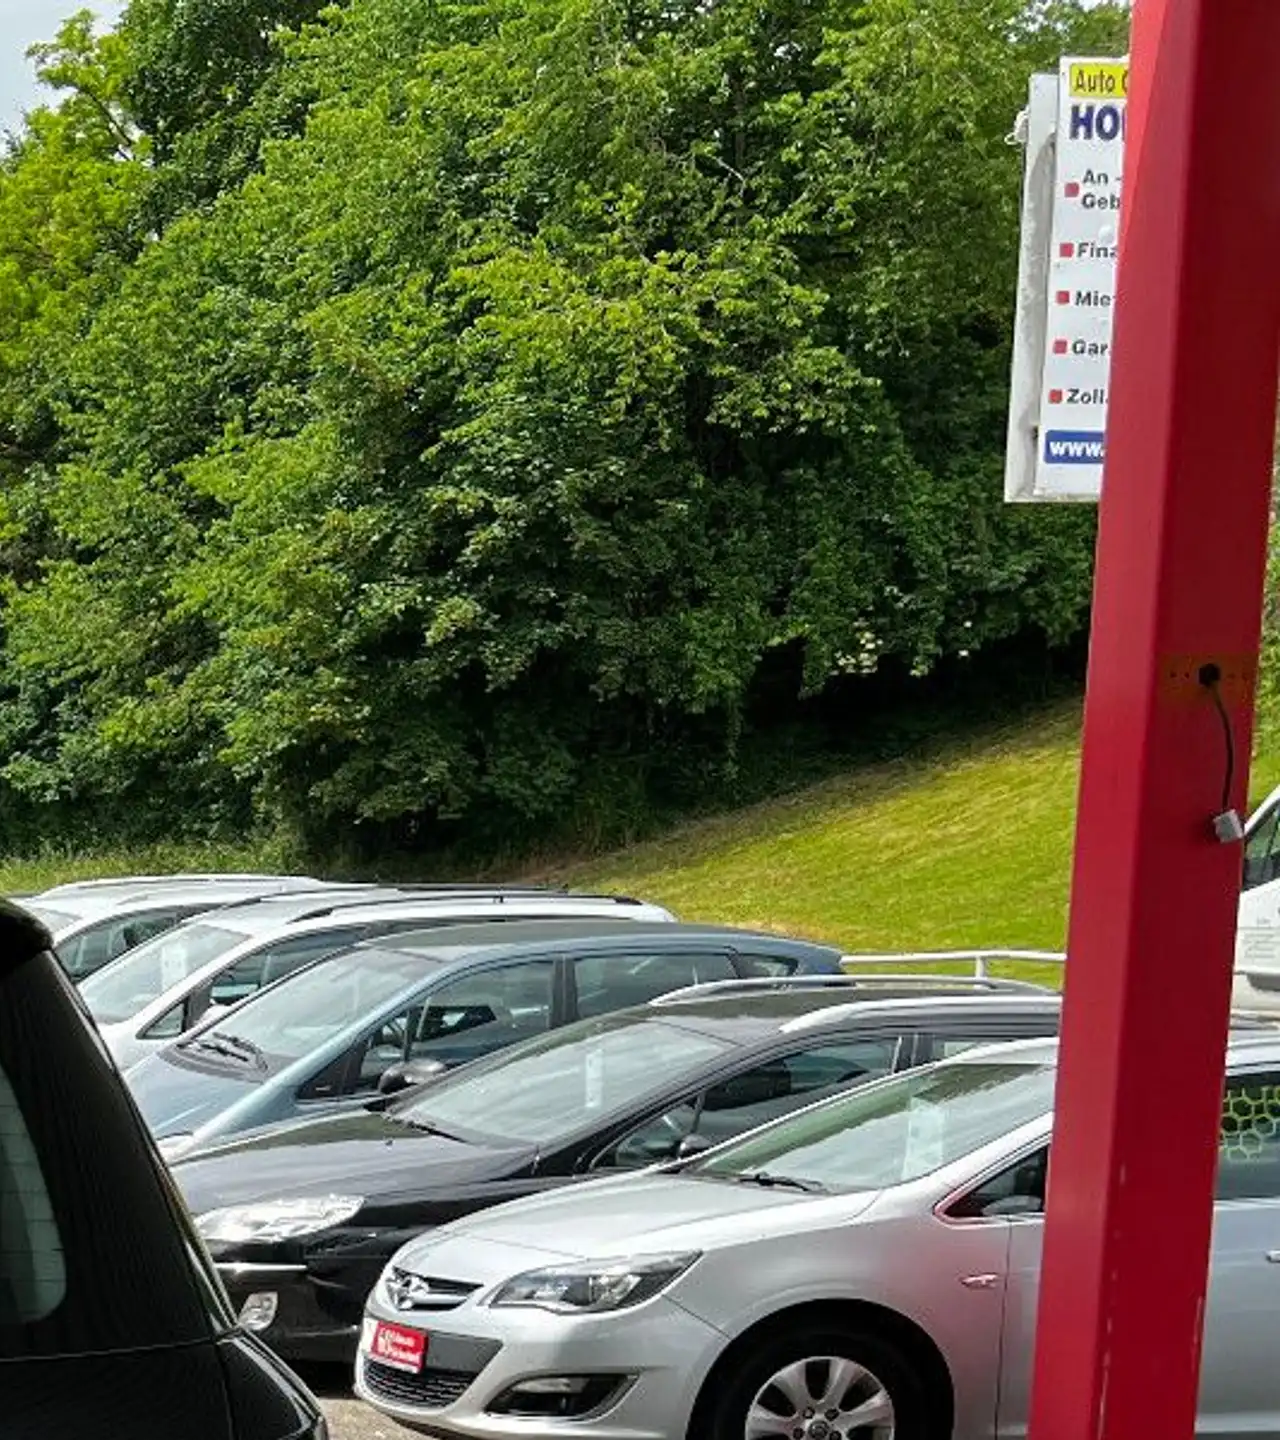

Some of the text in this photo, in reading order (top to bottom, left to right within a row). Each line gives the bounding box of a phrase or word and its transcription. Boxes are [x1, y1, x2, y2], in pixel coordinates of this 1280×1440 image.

[1074, 69, 1115, 93] Auto
[1070, 105, 1127, 140] HO
[1082, 169, 1108, 185] An
